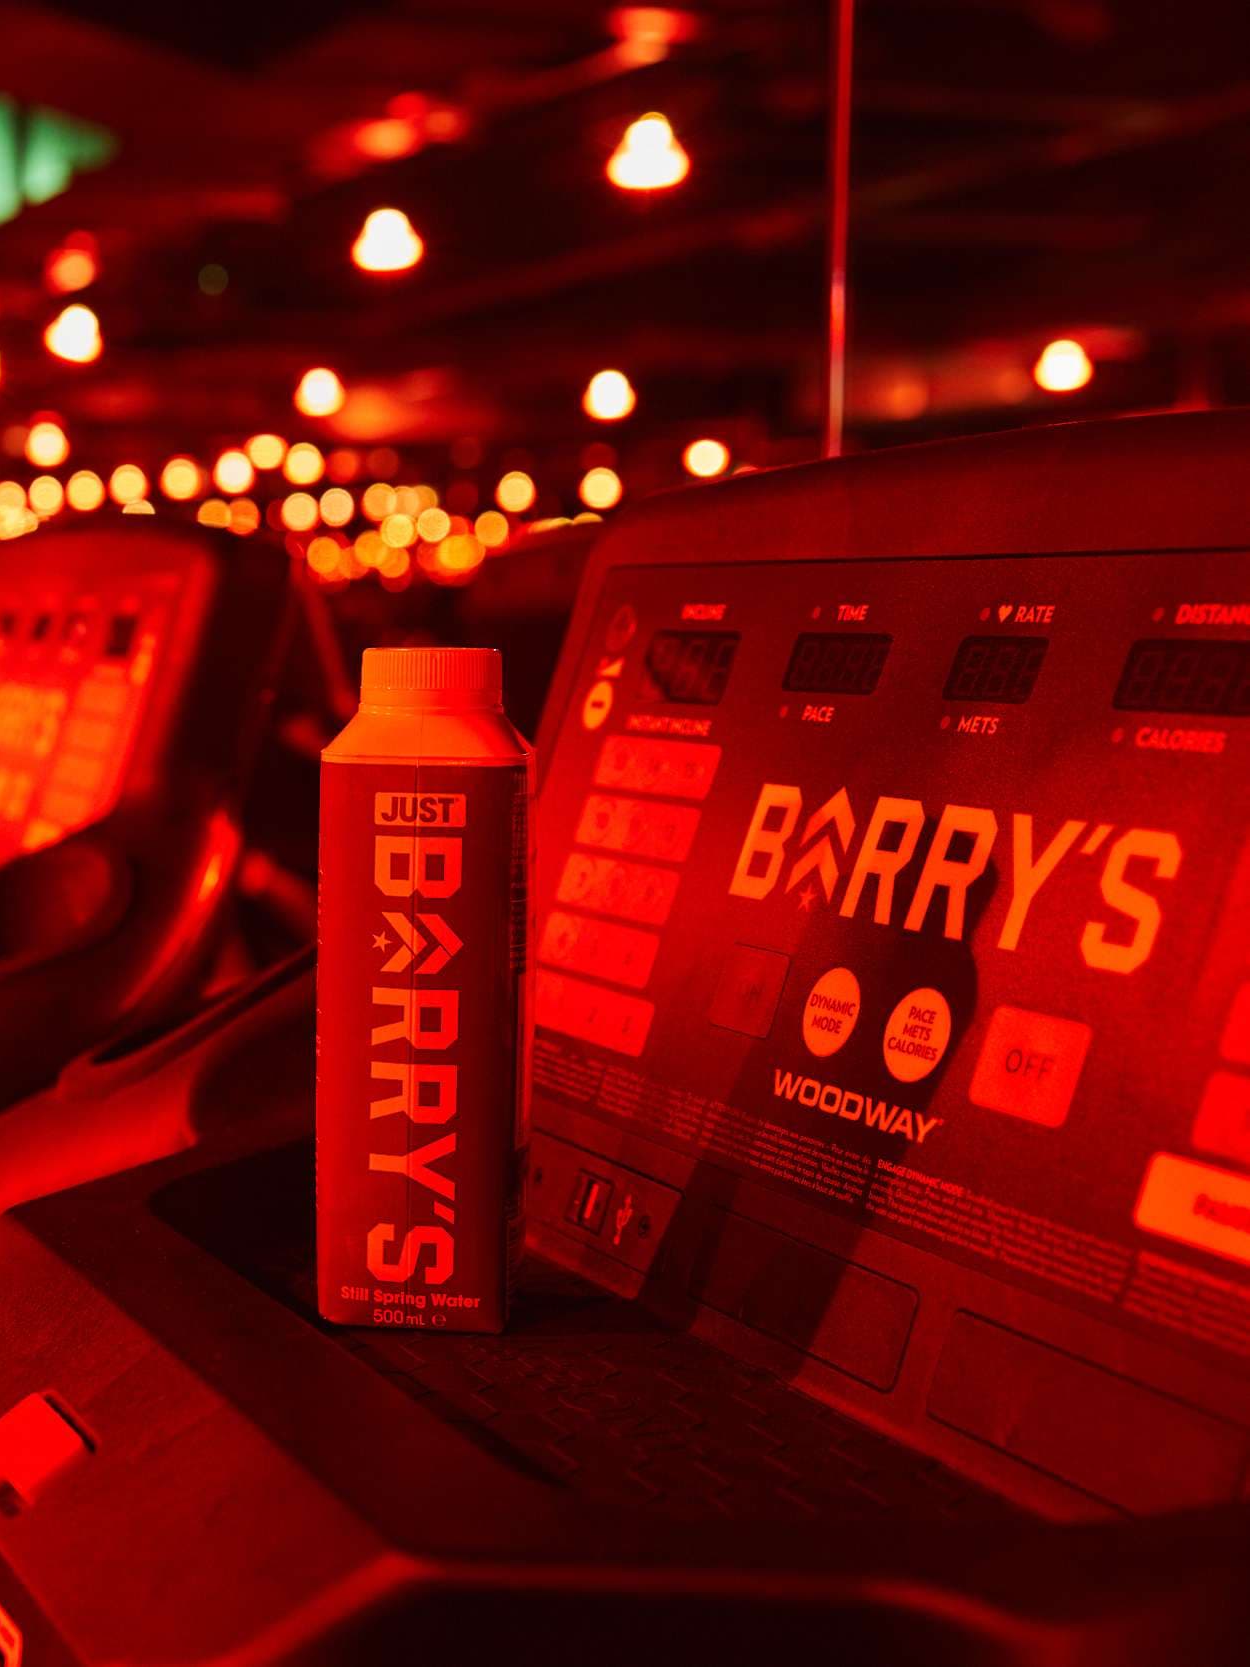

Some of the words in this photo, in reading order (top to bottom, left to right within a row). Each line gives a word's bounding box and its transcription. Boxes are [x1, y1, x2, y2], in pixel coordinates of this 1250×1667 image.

[837, 605, 869, 621] TIME
[1014, 606, 1055, 623] RATE
[801, 705, 835, 722] PACE
[957, 717, 999, 734] METS
[1135, 727, 1227, 753] CALORIES
[381, 796, 454, 823] JUST
[809, 993, 857, 1017] DYNAMIC
[908, 1005, 938, 1025] PACE
[811, 1015, 843, 1034] MODE
[902, 1023, 933, 1042] METS
[887, 1036, 939, 1062] CALORIES
[1005, 1049, 1054, 1081] OFF
[773, 1068, 938, 1144] WOODWAY
[341, 1286, 369, 1301] Still
[373, 1289, 426, 1309] Spring
[430, 1293, 480, 1308] Water
